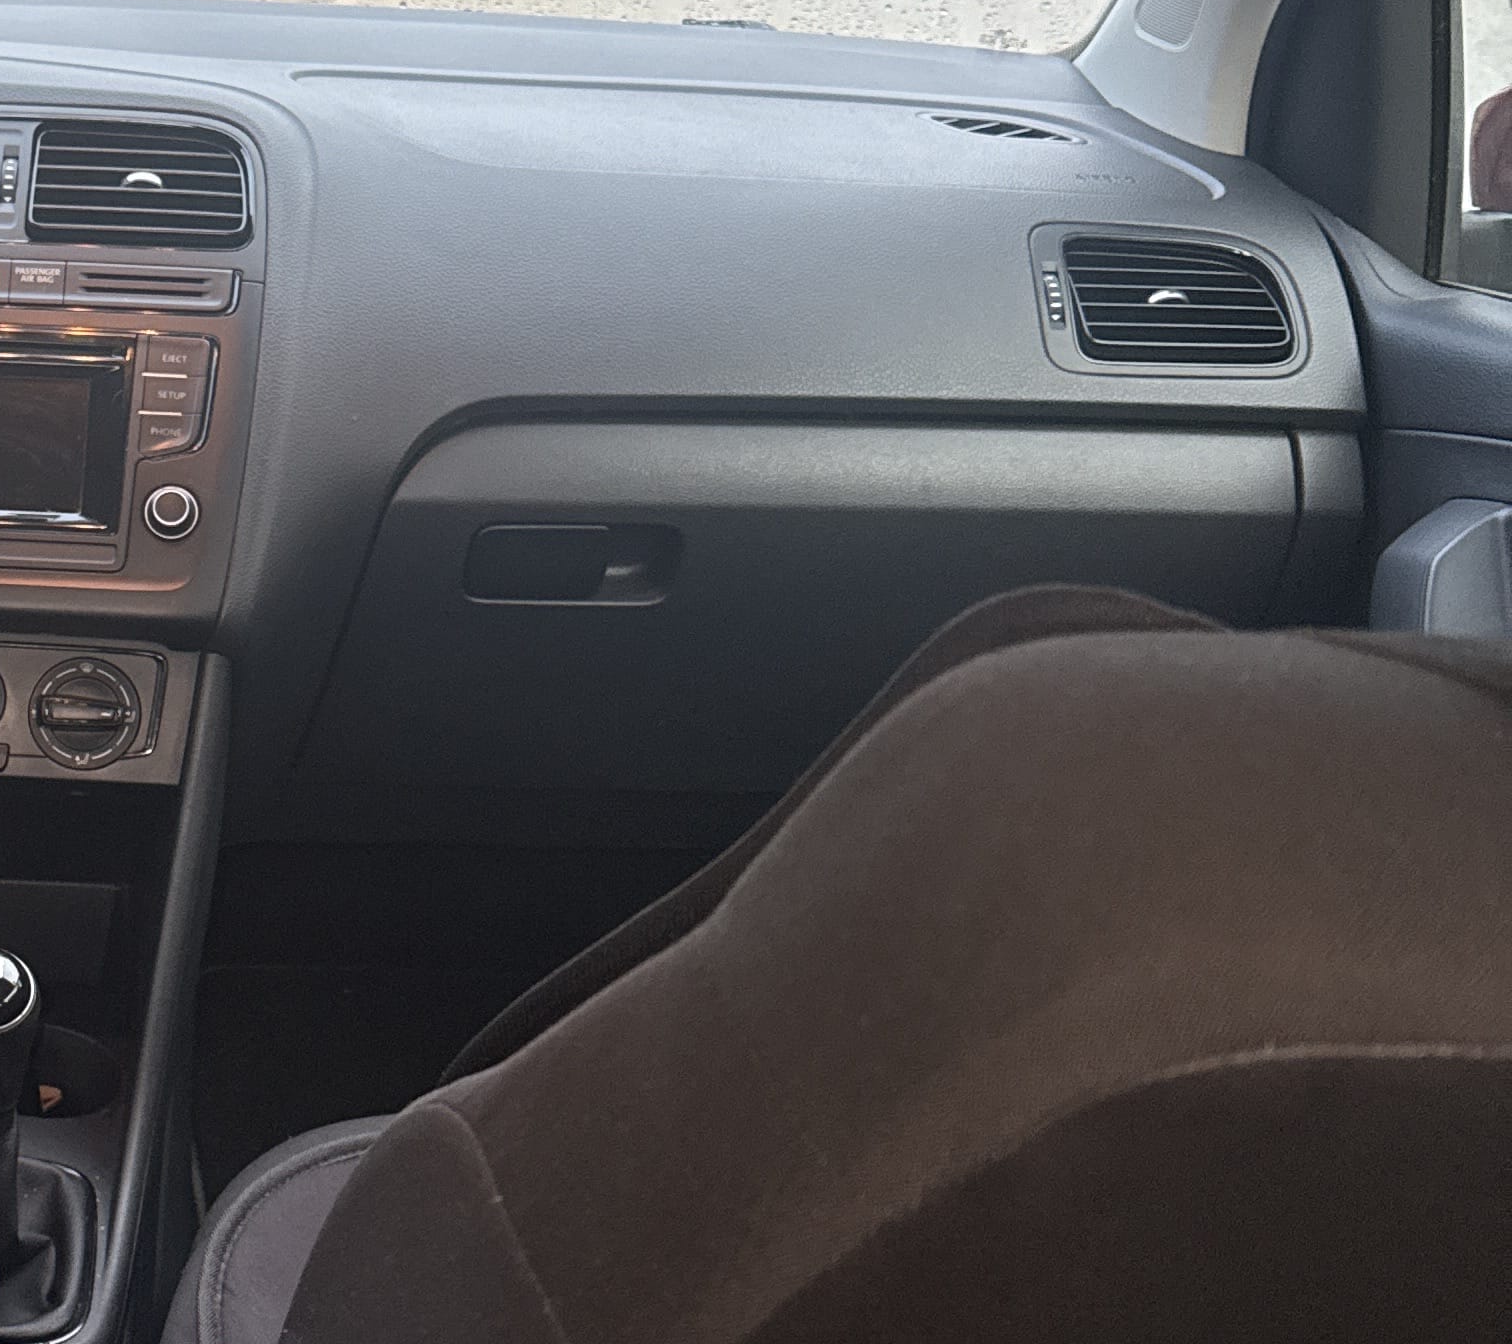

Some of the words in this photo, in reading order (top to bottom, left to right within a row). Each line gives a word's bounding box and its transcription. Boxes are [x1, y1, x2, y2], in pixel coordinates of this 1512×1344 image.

[15, 266, 61, 276] PASSENGER
[20, 274, 35, 283] AIR
[36, 275, 54, 284] BAG
[161, 353, 188, 364] EJECT
[157, 390, 186, 400] SETUP
[150, 426, 181, 437] PHONE
